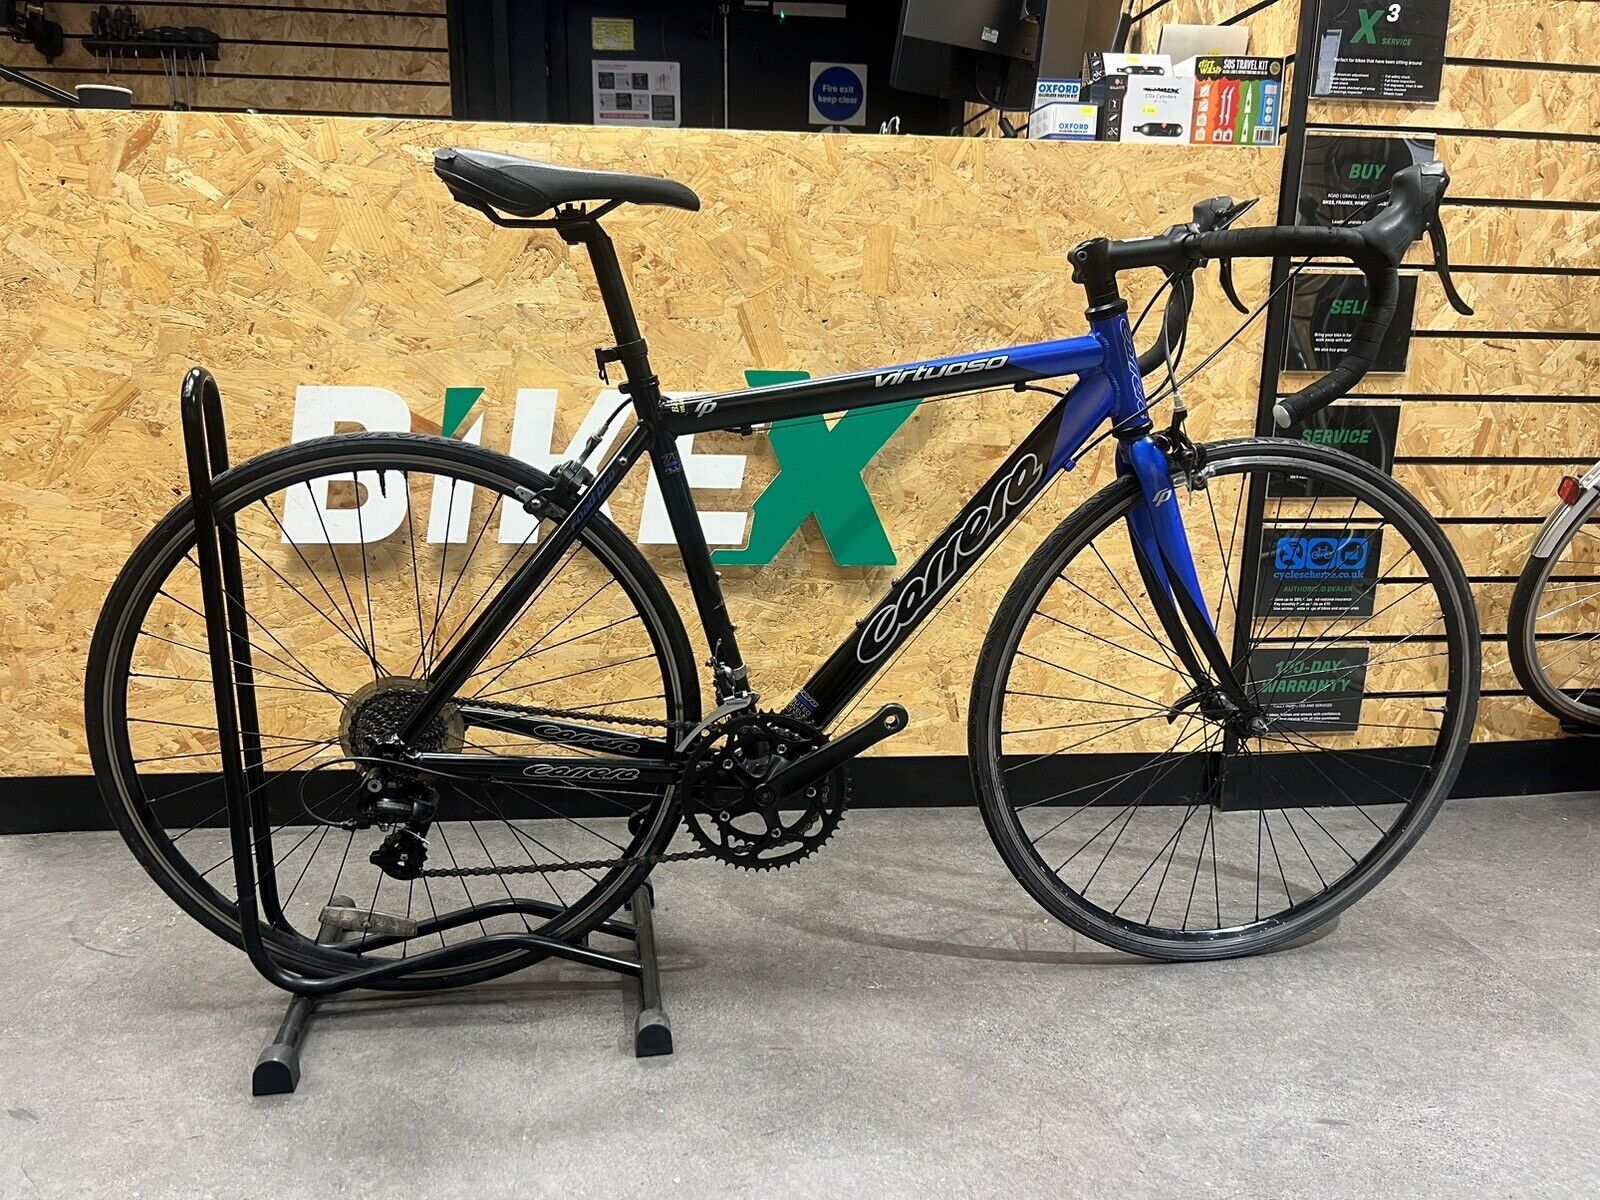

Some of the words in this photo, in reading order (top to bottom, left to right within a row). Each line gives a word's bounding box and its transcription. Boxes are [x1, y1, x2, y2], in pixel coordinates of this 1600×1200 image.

[1381, 38, 1412, 46] SERVICE
[1223, 59, 1235, 70] SOS
[1236, 59, 1258, 70] TRAVEL
[1258, 60, 1269, 71] KIT
[822, 84, 837, 93] Fire
[840, 85, 854, 94] exit
[1038, 84, 1078, 93] OXFORD
[818, 95, 837, 105] keep
[838, 96, 857, 105] clear
[1349, 164, 1387, 179] BUY
[1301, 428, 1371, 444] SERVICE
[1263, 678, 1352, 693] WARRANTY
[522, 763, 640, 782] Carrera
